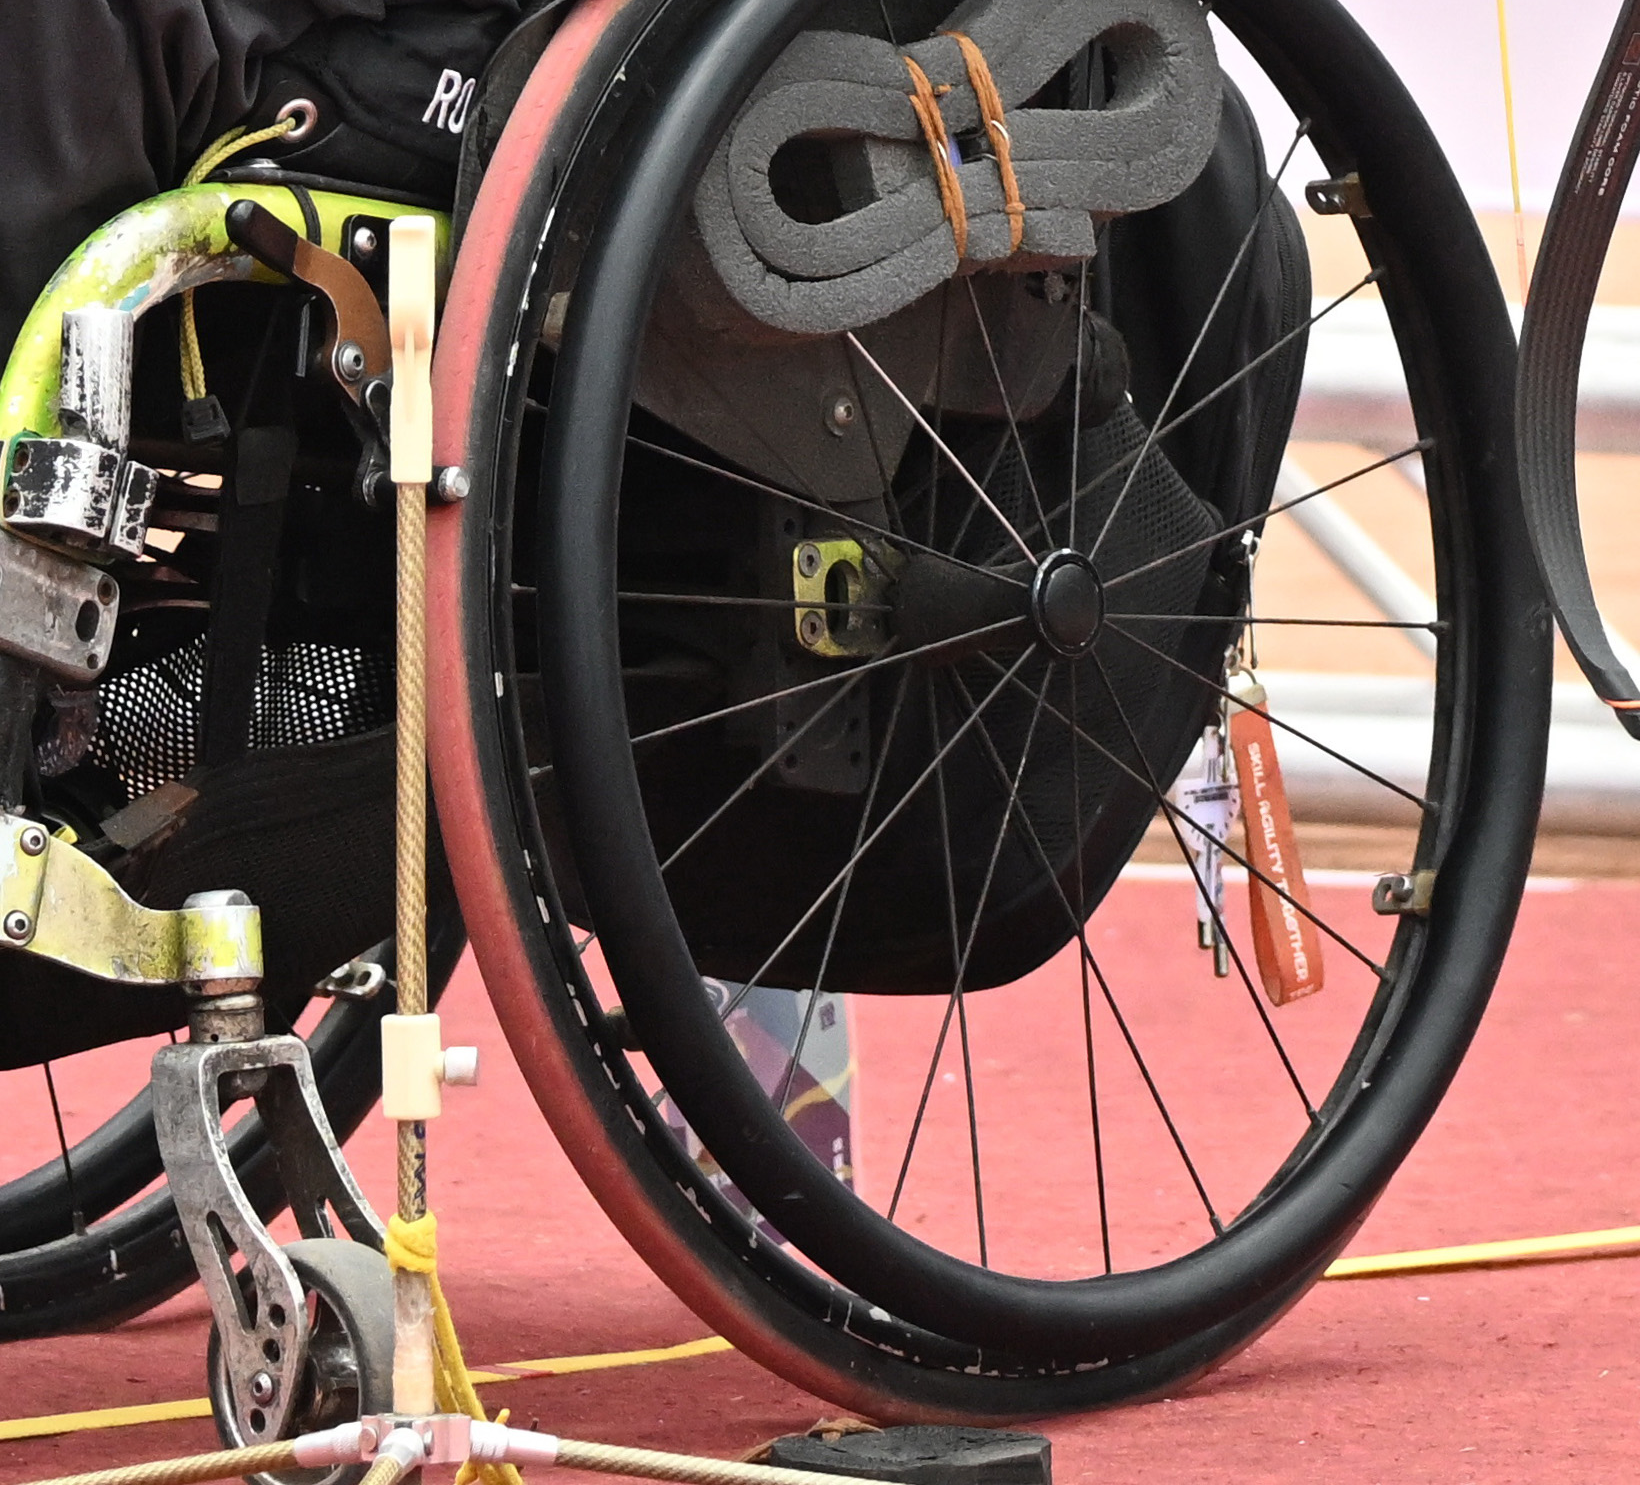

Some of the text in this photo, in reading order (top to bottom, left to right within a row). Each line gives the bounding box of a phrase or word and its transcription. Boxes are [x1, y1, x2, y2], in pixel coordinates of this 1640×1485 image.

[1613, 114, 1631, 153] FOAM
[1247, 742, 1262, 797] SKILL
[1258, 801, 1285, 874] AGILITY
